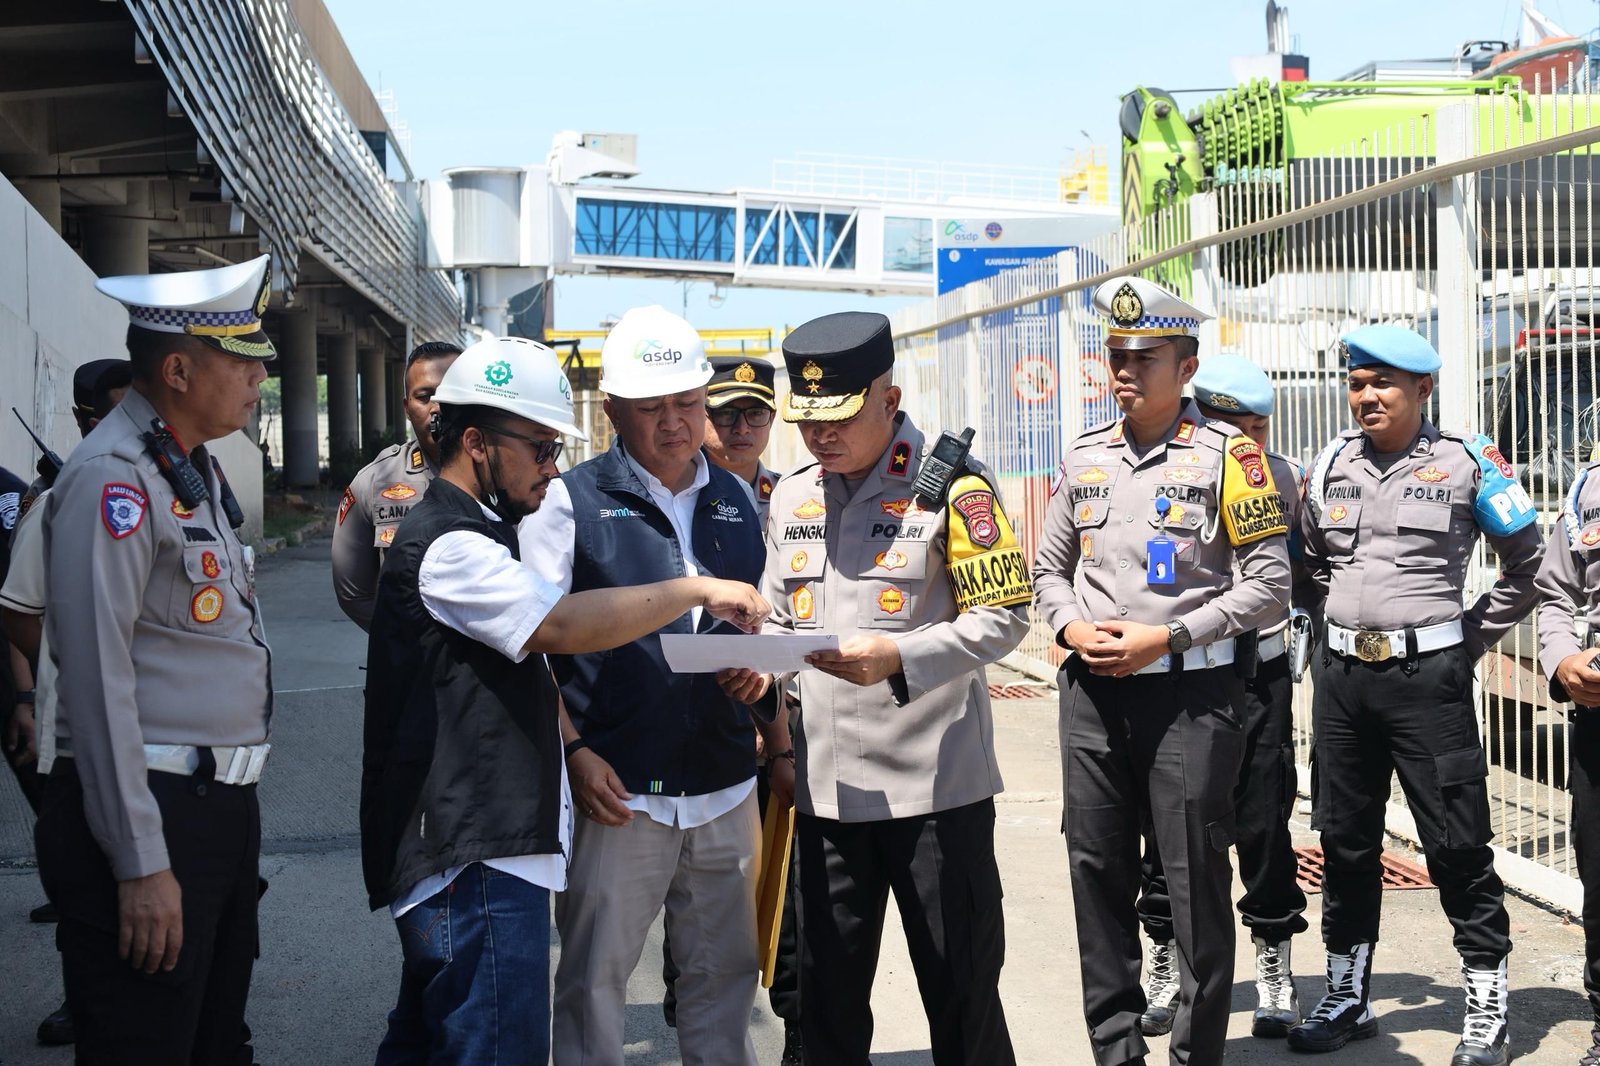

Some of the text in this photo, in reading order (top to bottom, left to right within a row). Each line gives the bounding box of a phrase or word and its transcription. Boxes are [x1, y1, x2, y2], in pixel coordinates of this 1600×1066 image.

[954, 232, 979, 242] asdp
[984, 258, 1021, 267] KAWASAN
[642, 348, 683, 364] asdp
[960, 495, 988, 507] POLDA
[1155, 486, 1202, 502] POLRI
[1402, 487, 1452, 503] POLRI
[717, 504, 739, 516] asdp
[783, 523, 828, 540] HENGKI
[871, 523, 926, 538] POLRI
[969, 590, 1001, 609] KETUPAT
